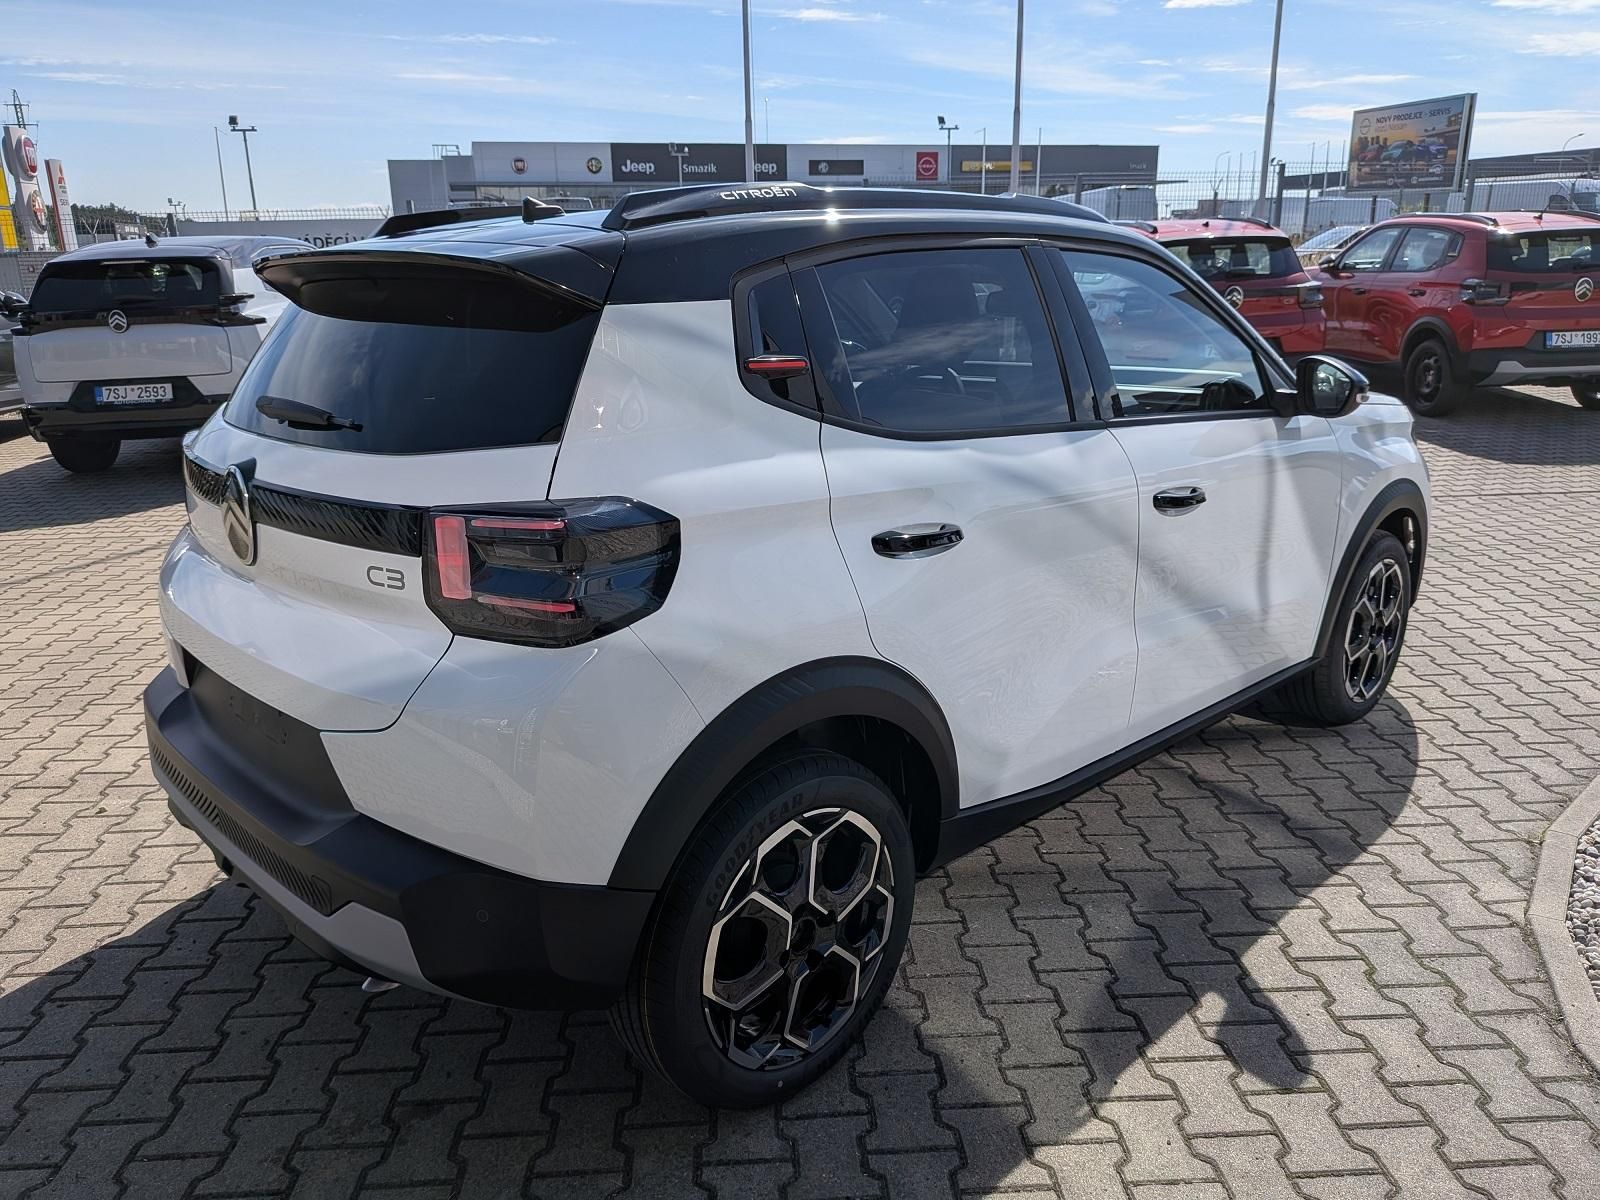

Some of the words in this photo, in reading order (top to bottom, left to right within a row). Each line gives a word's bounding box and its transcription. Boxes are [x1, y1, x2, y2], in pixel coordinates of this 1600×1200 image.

[621, 159, 656, 174] Jeep
[682, 162, 717, 173] Smazik
[754, 162, 778, 174] eep
[1581, 332, 1600, 344] 199
[366, 565, 405, 590] C3
[705, 793, 804, 906] GOODYEAR
